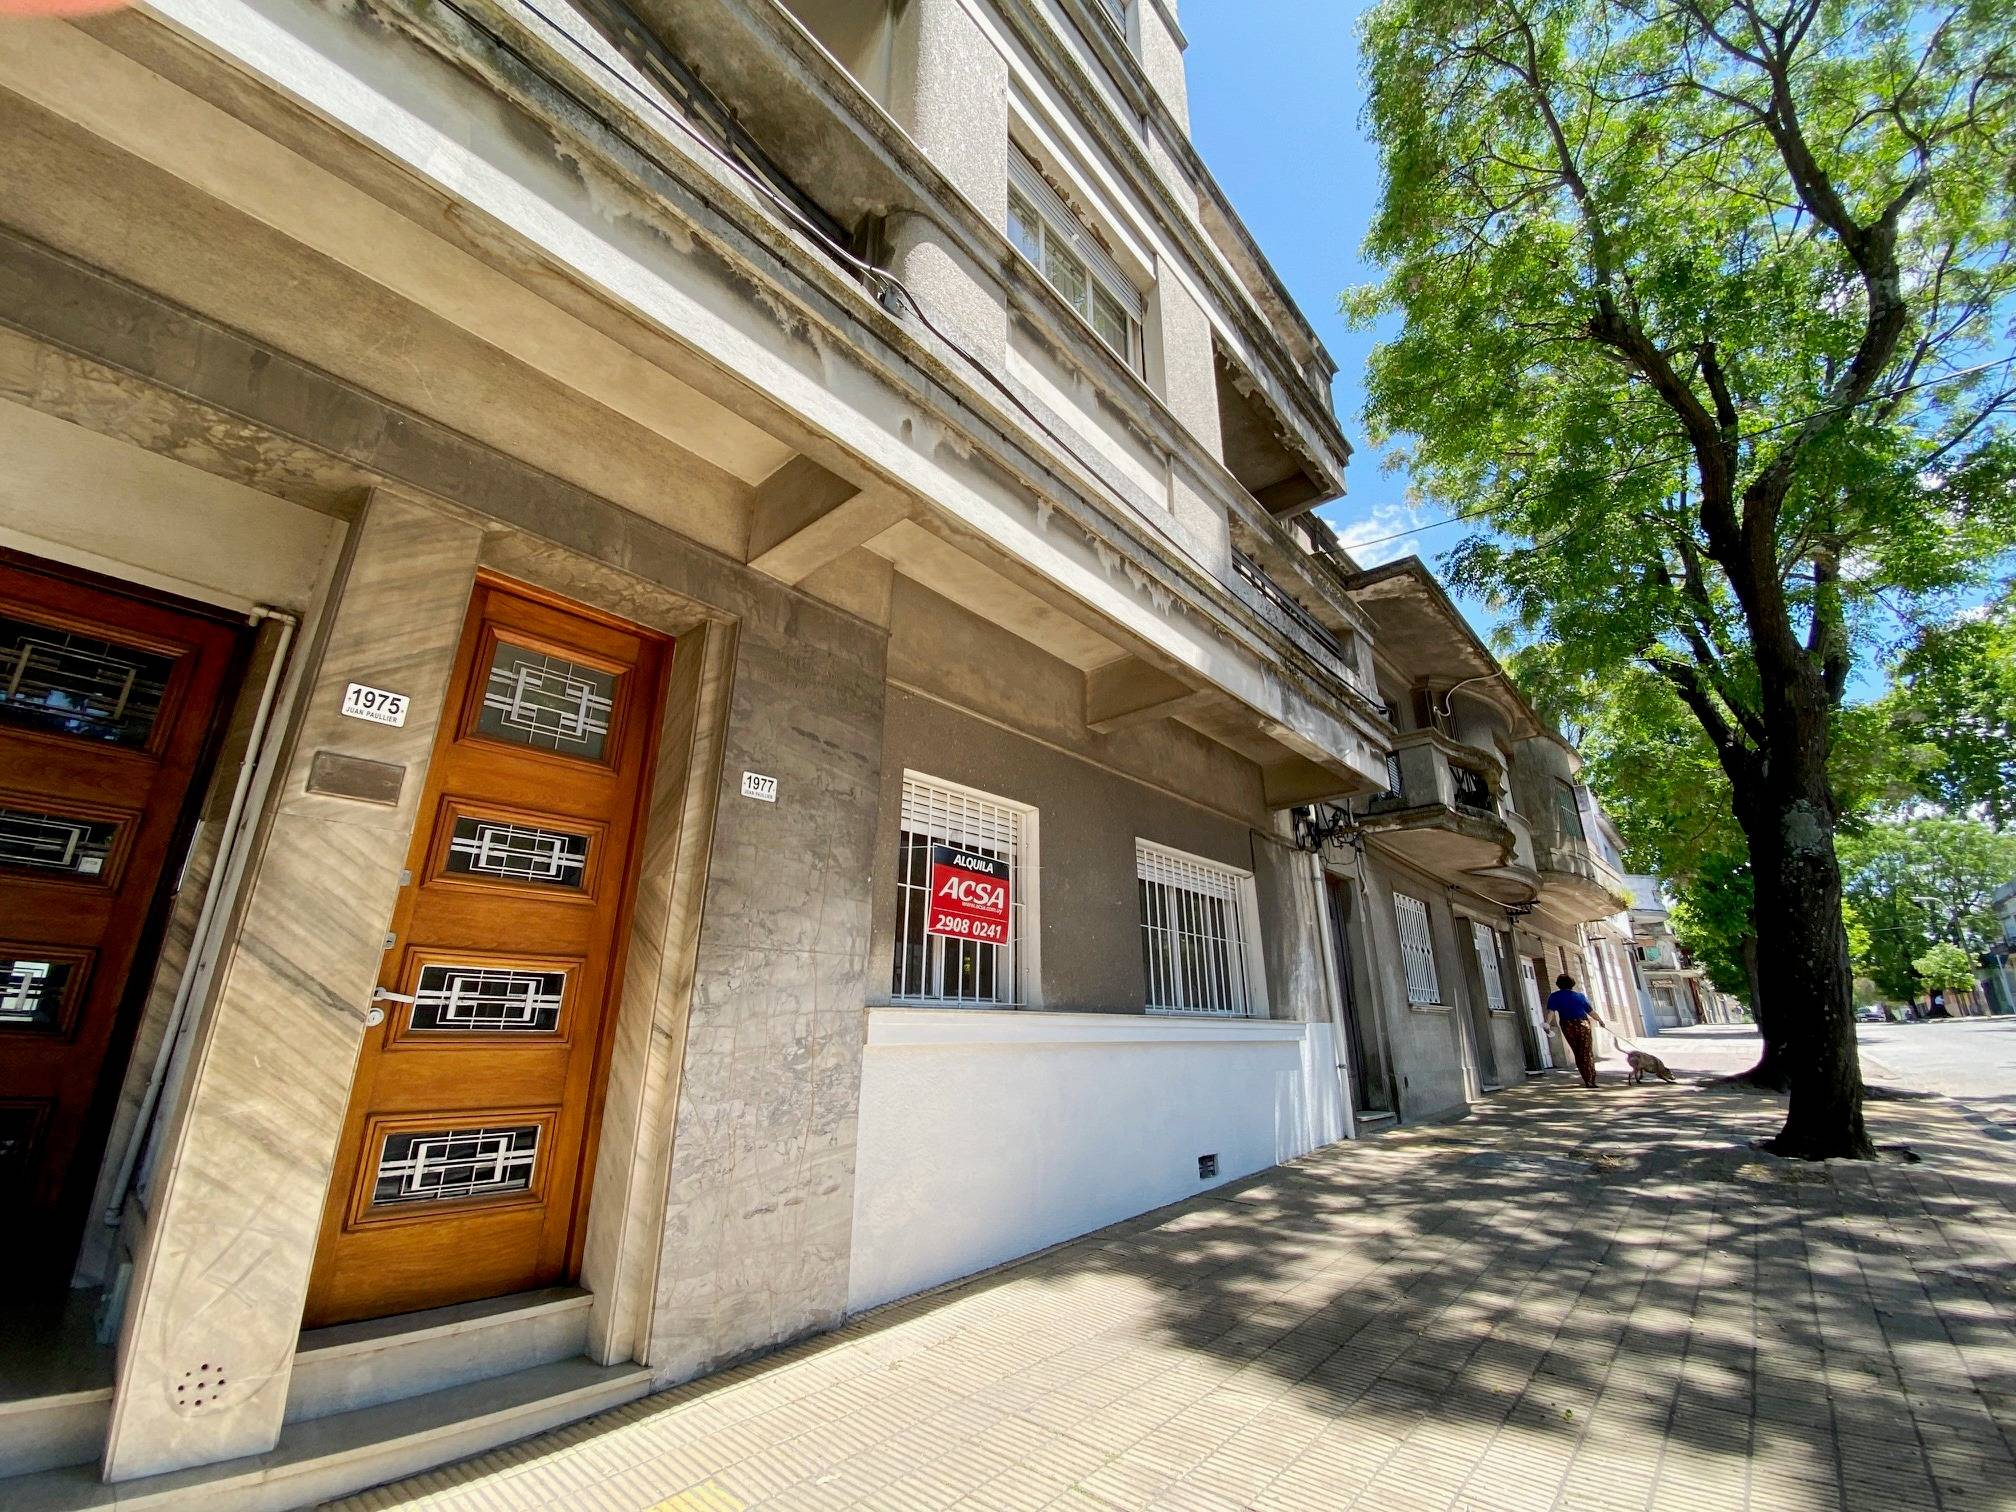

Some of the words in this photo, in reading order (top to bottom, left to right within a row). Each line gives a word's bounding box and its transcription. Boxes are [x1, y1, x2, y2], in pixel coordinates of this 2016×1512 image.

[352, 688, 402, 714] 1975
[346, 706, 365, 715] JUAN
[366, 710, 398, 723] PAULLIER
[746, 775, 774, 793] 1977
[953, 854, 994, 874] ALQUILA
[938, 876, 1004, 909] ACSA
[935, 914, 970, 934] 2908
[972, 921, 1002, 939] 0241
